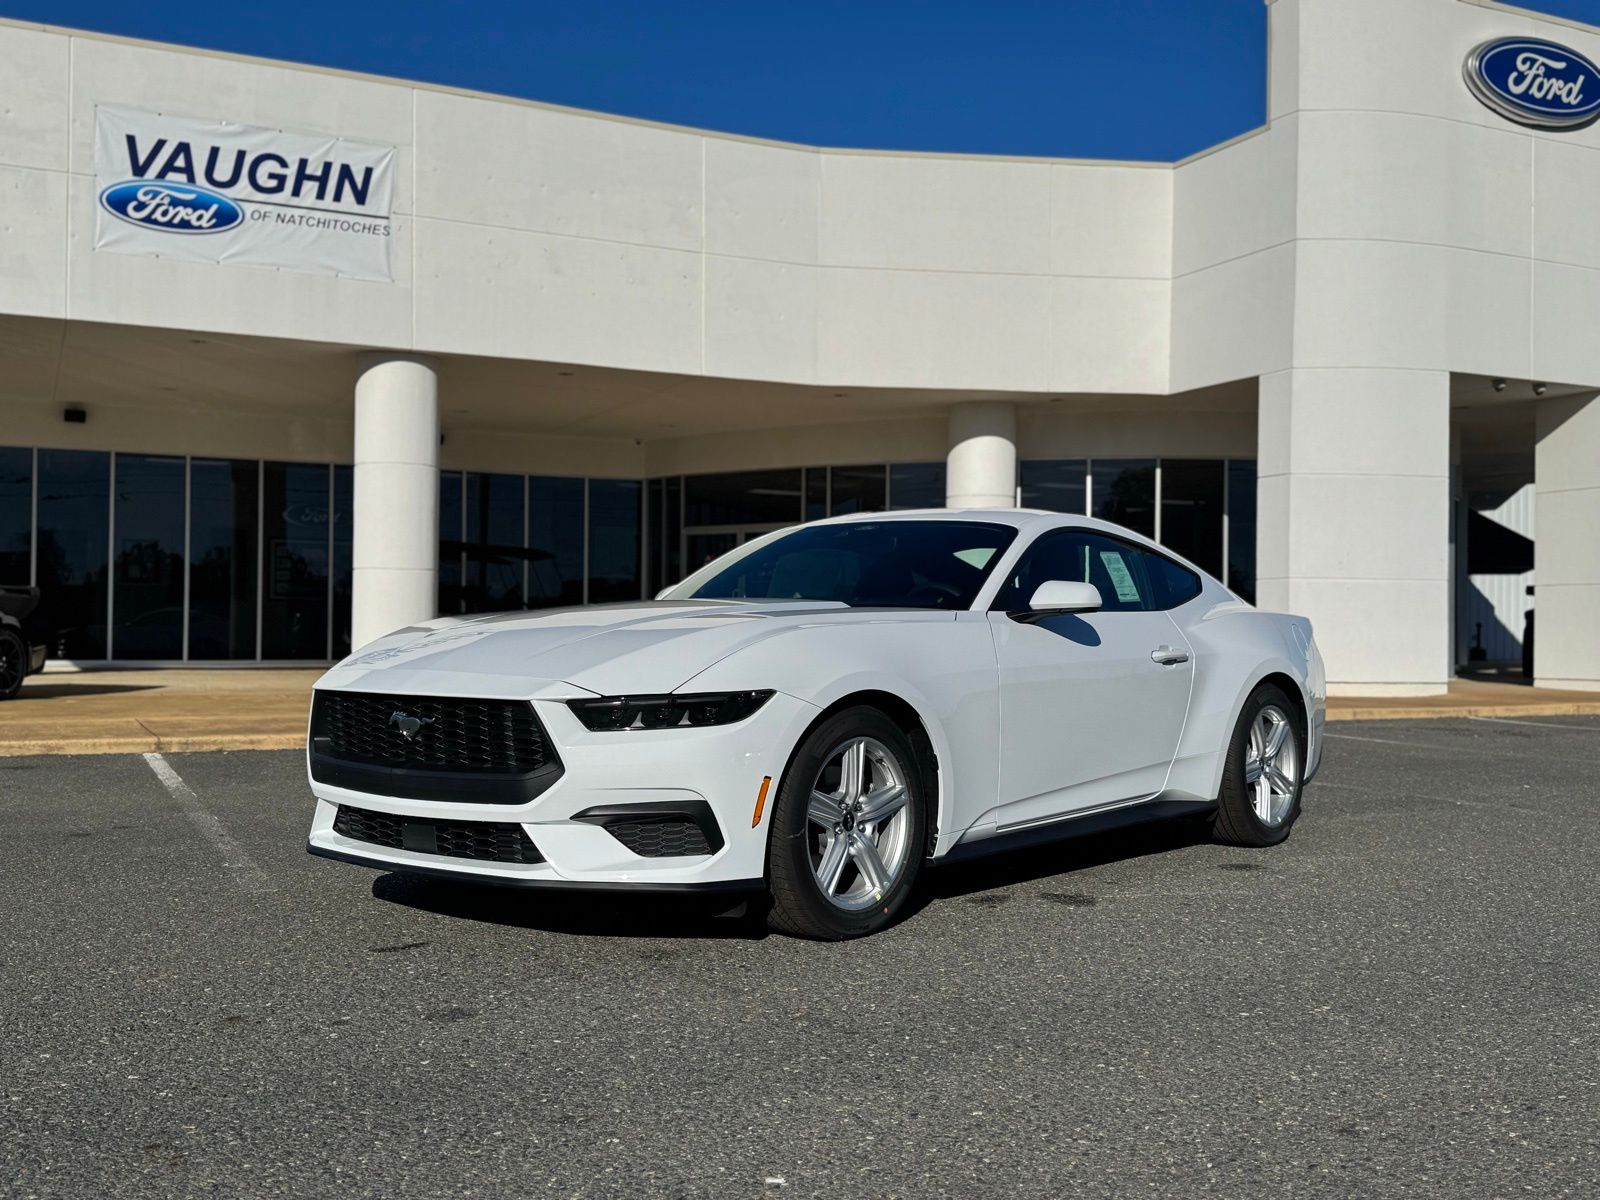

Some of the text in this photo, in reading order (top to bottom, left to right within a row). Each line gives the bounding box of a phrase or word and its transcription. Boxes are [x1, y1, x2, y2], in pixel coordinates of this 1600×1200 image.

[1507, 52, 1585, 105] Ford
[125, 133, 374, 206] VAUGHN
[126, 186, 220, 229] Ford
[250, 209, 391, 237] OF NATCHITOCHES
